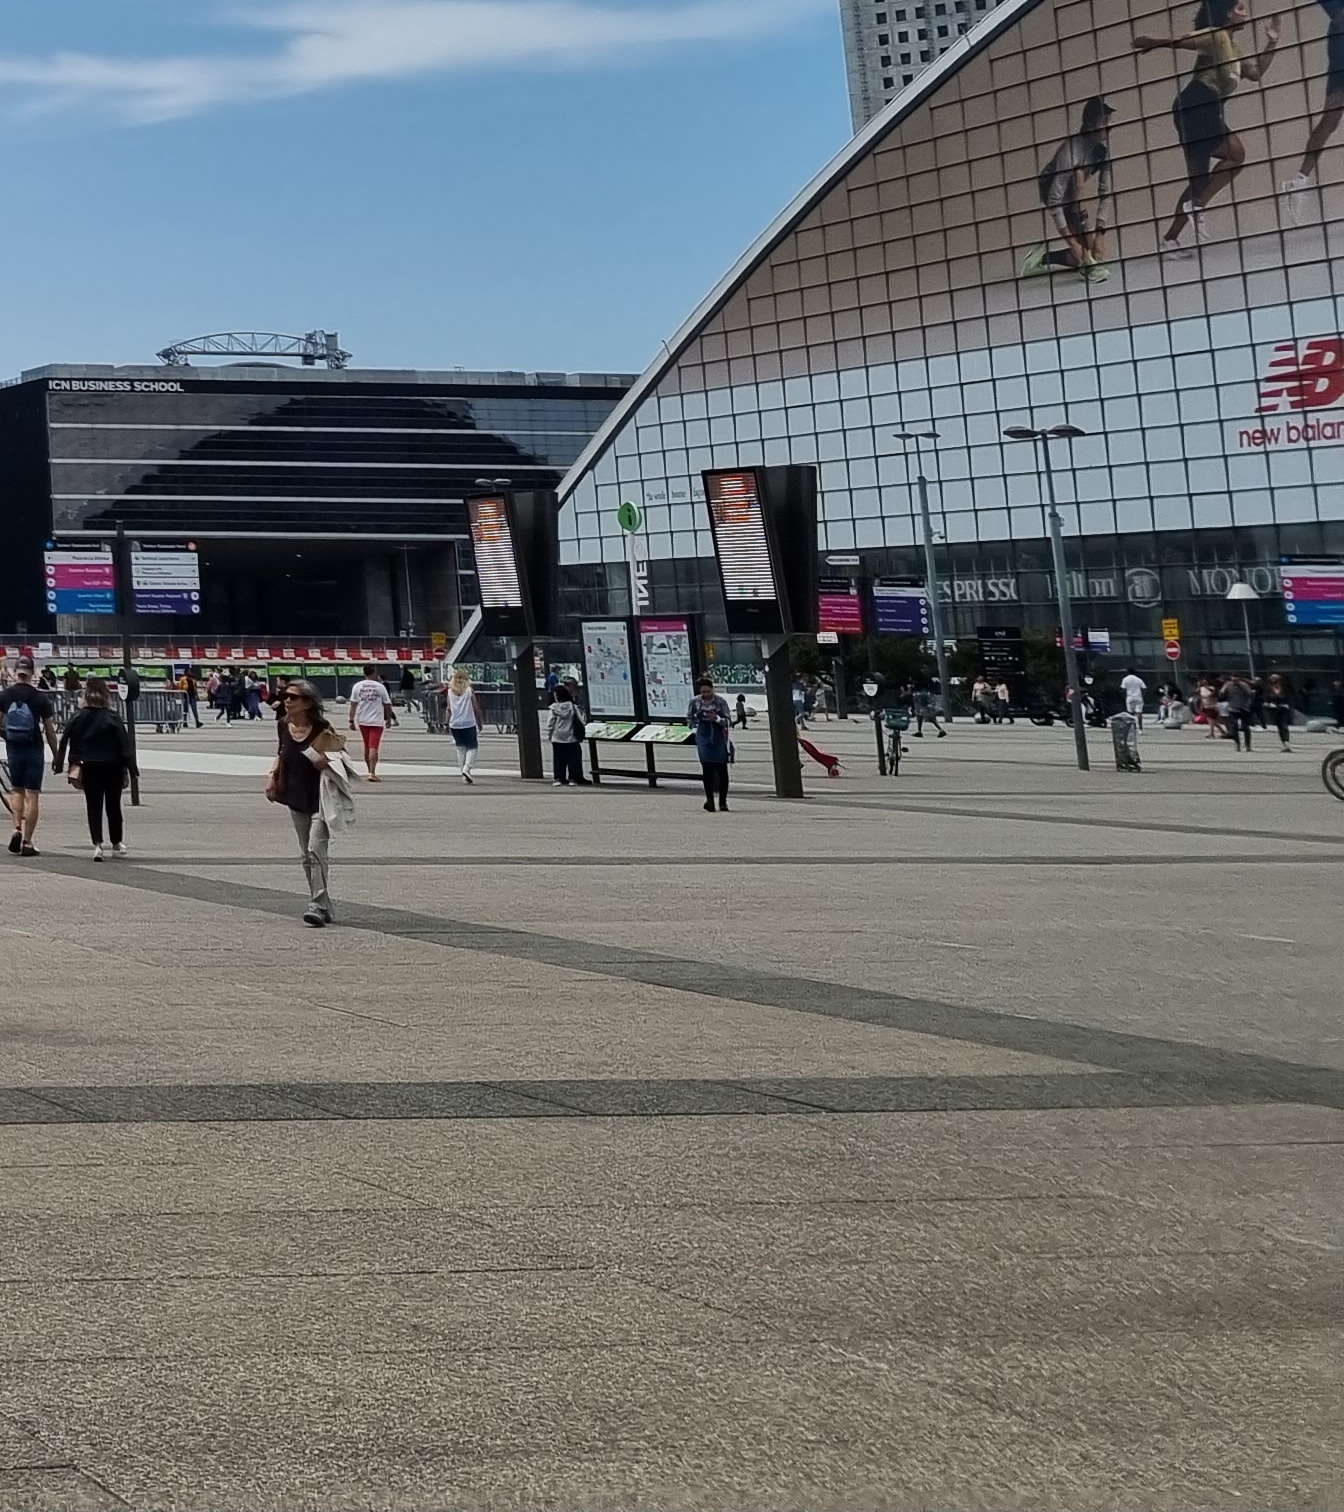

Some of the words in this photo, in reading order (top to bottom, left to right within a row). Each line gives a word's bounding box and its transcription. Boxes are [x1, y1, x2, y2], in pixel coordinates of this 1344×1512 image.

[48, 380, 71, 390] ICN
[72, 380, 131, 391] BUSINESS
[134, 382, 184, 392] SCHOOL
[1239, 427, 1281, 448] new
